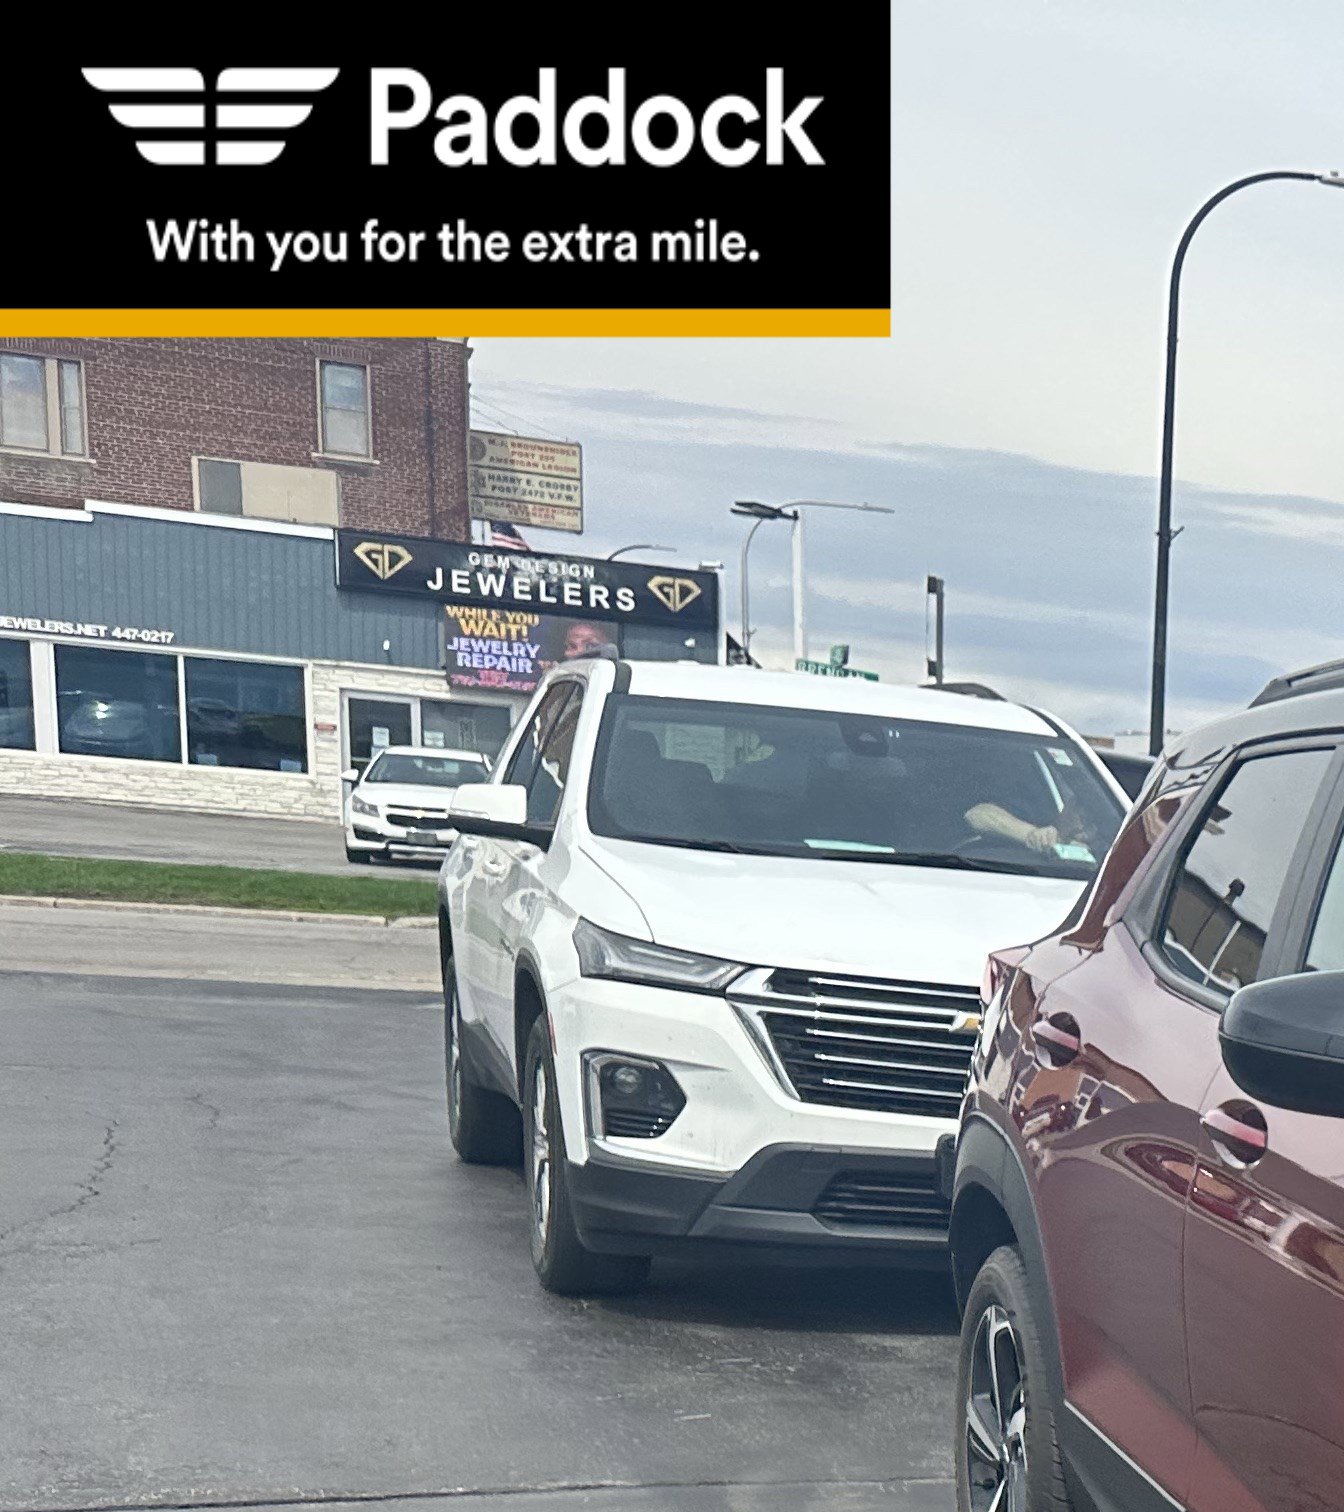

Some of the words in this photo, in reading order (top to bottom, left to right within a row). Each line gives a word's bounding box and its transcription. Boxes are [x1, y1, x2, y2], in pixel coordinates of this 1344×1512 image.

[516, 556, 596, 580] DESIGN
[426, 567, 637, 612] JEWELERS
[504, 610, 540, 626] YOU
[459, 617, 529, 643] WAIT!
[446, 637, 541, 659] JEWELRY
[456, 651, 533, 674] REPAIR
